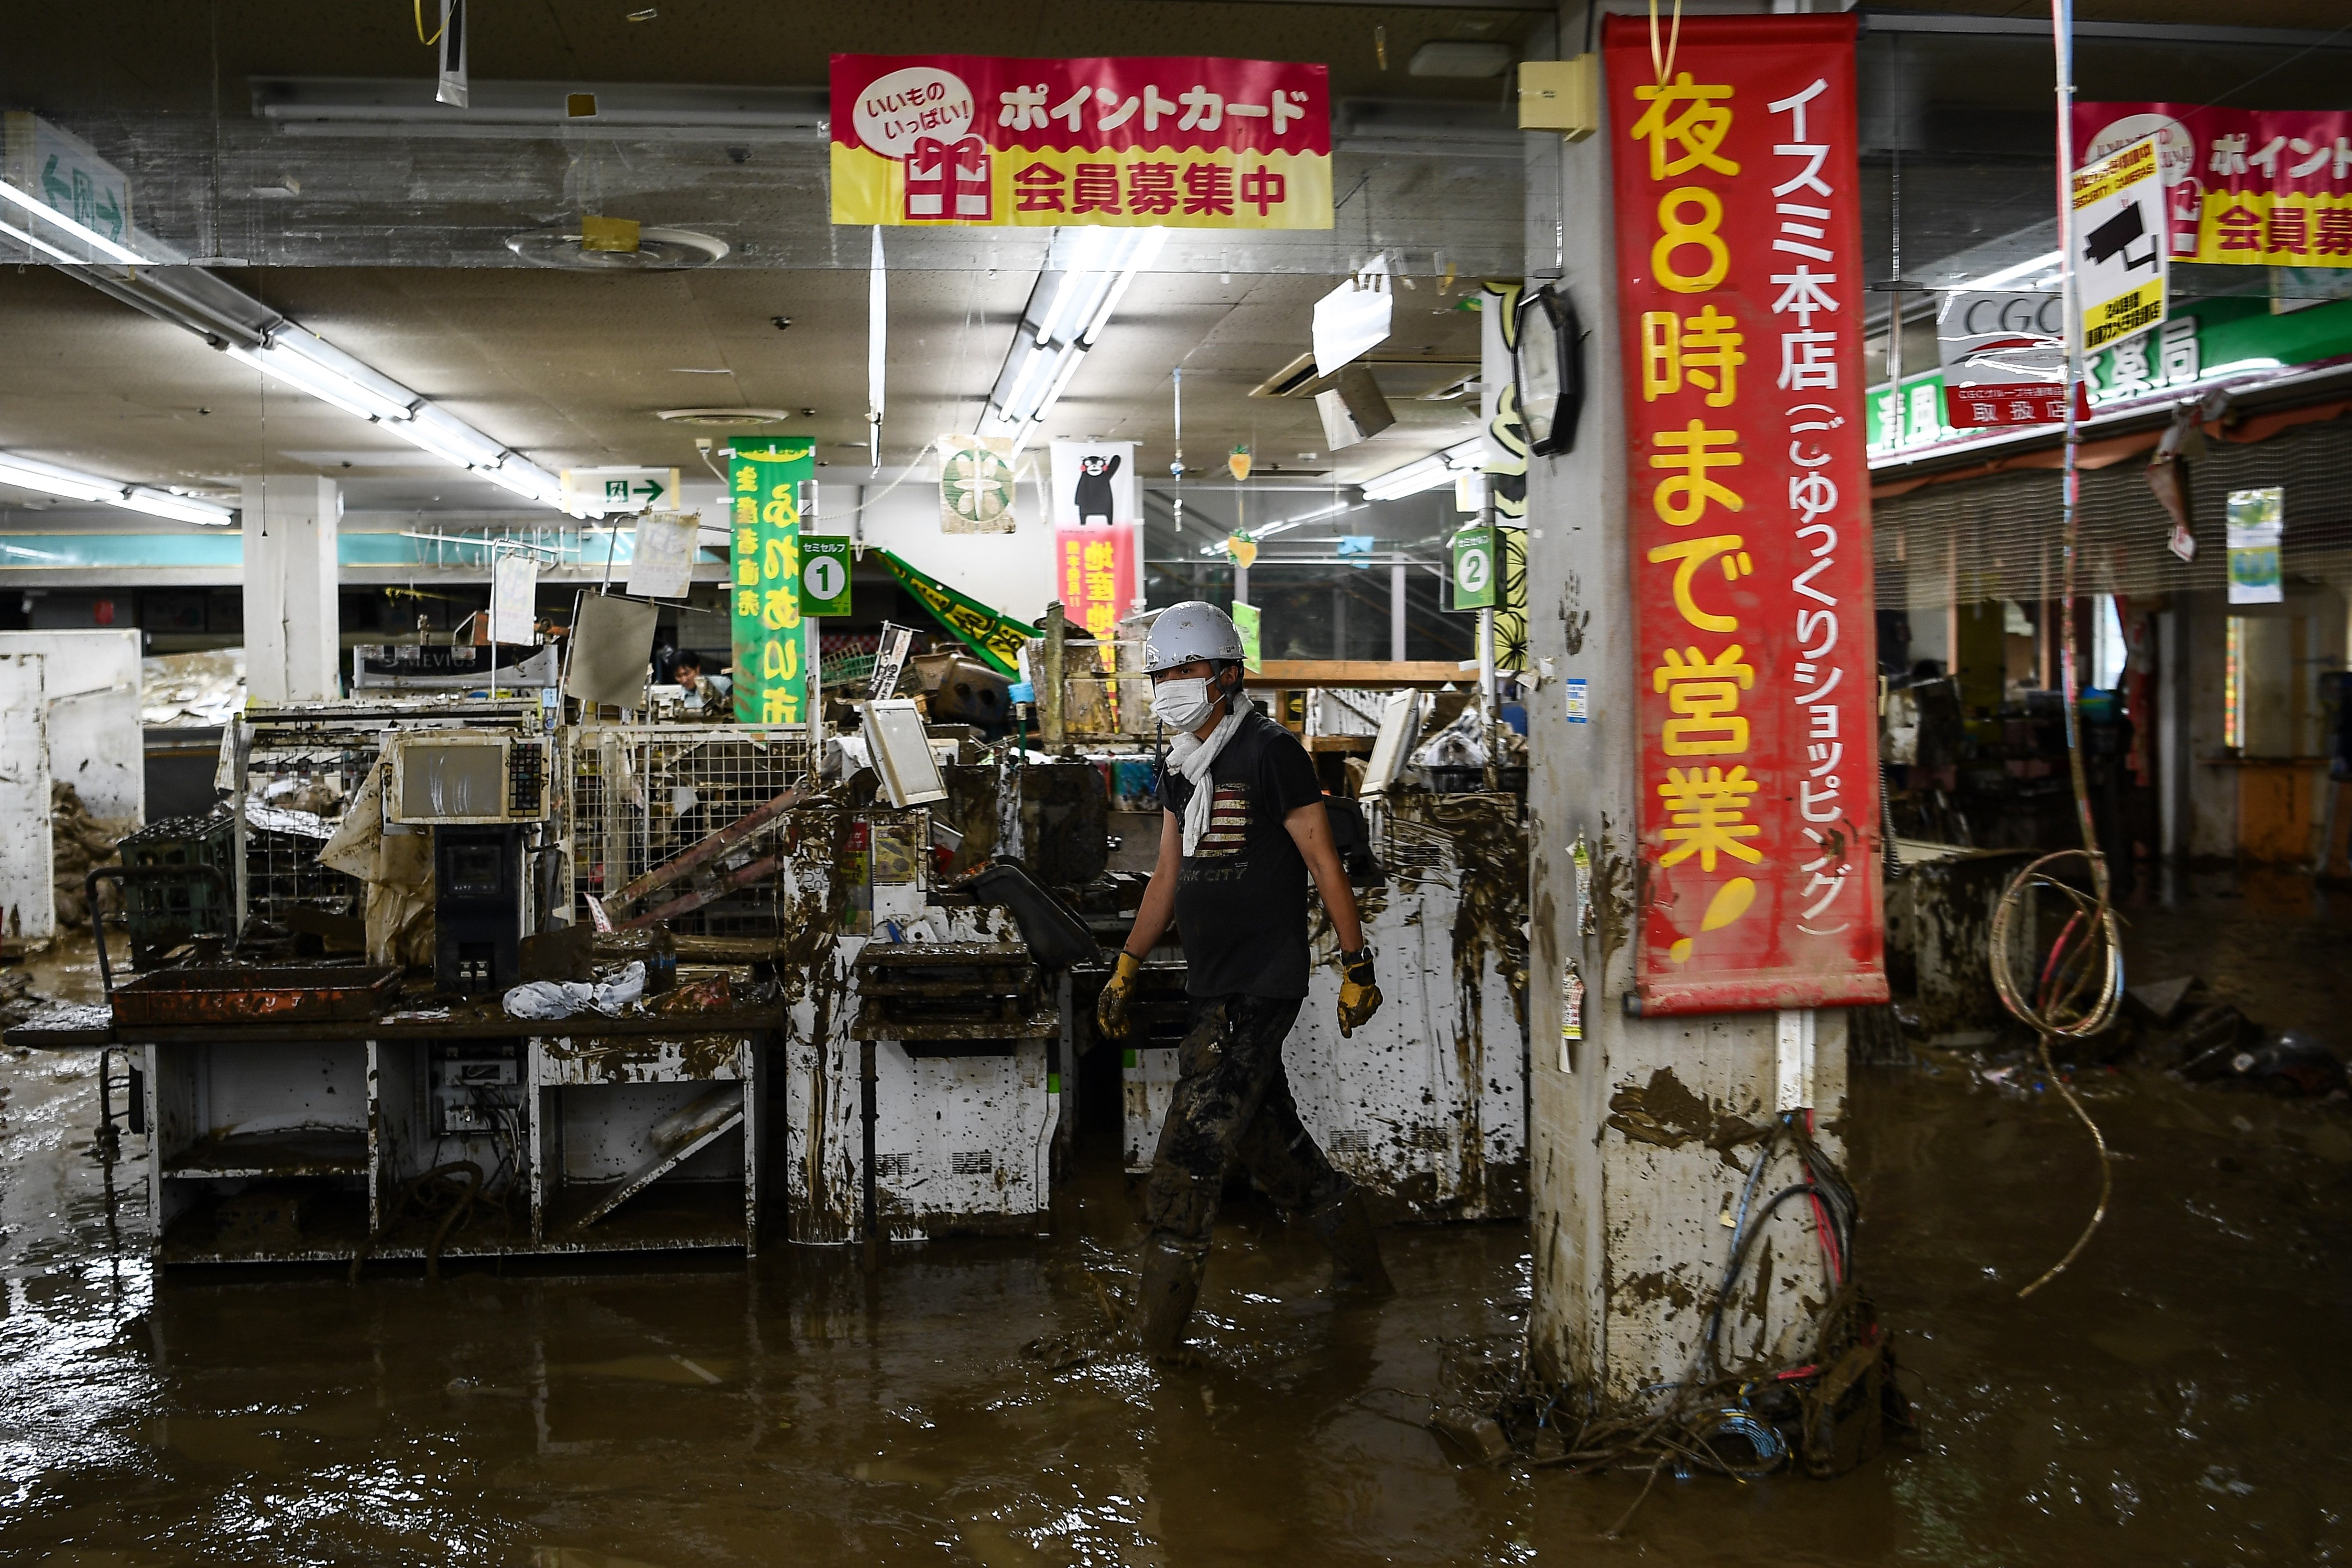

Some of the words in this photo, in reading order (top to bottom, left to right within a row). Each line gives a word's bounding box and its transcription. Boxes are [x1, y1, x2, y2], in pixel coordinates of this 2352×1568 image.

[865, 80, 945, 116] いいもの
[998, 83, 1310, 136] ポイントカード
[884, 99, 970, 139] いっぱい!
[2208, 133, 2352, 179] ポイント
[1014, 162, 1285, 217] 会員募集中
[1964, 296, 2064, 334] CGC
[1630, 72, 1764, 964] 夜8時まで営業!
[803, 543, 846, 553] セミセルフ
[816, 563, 829, 592] 1
[1467, 555, 1480, 584] 2
[1204, 867, 1247, 881] CITY
